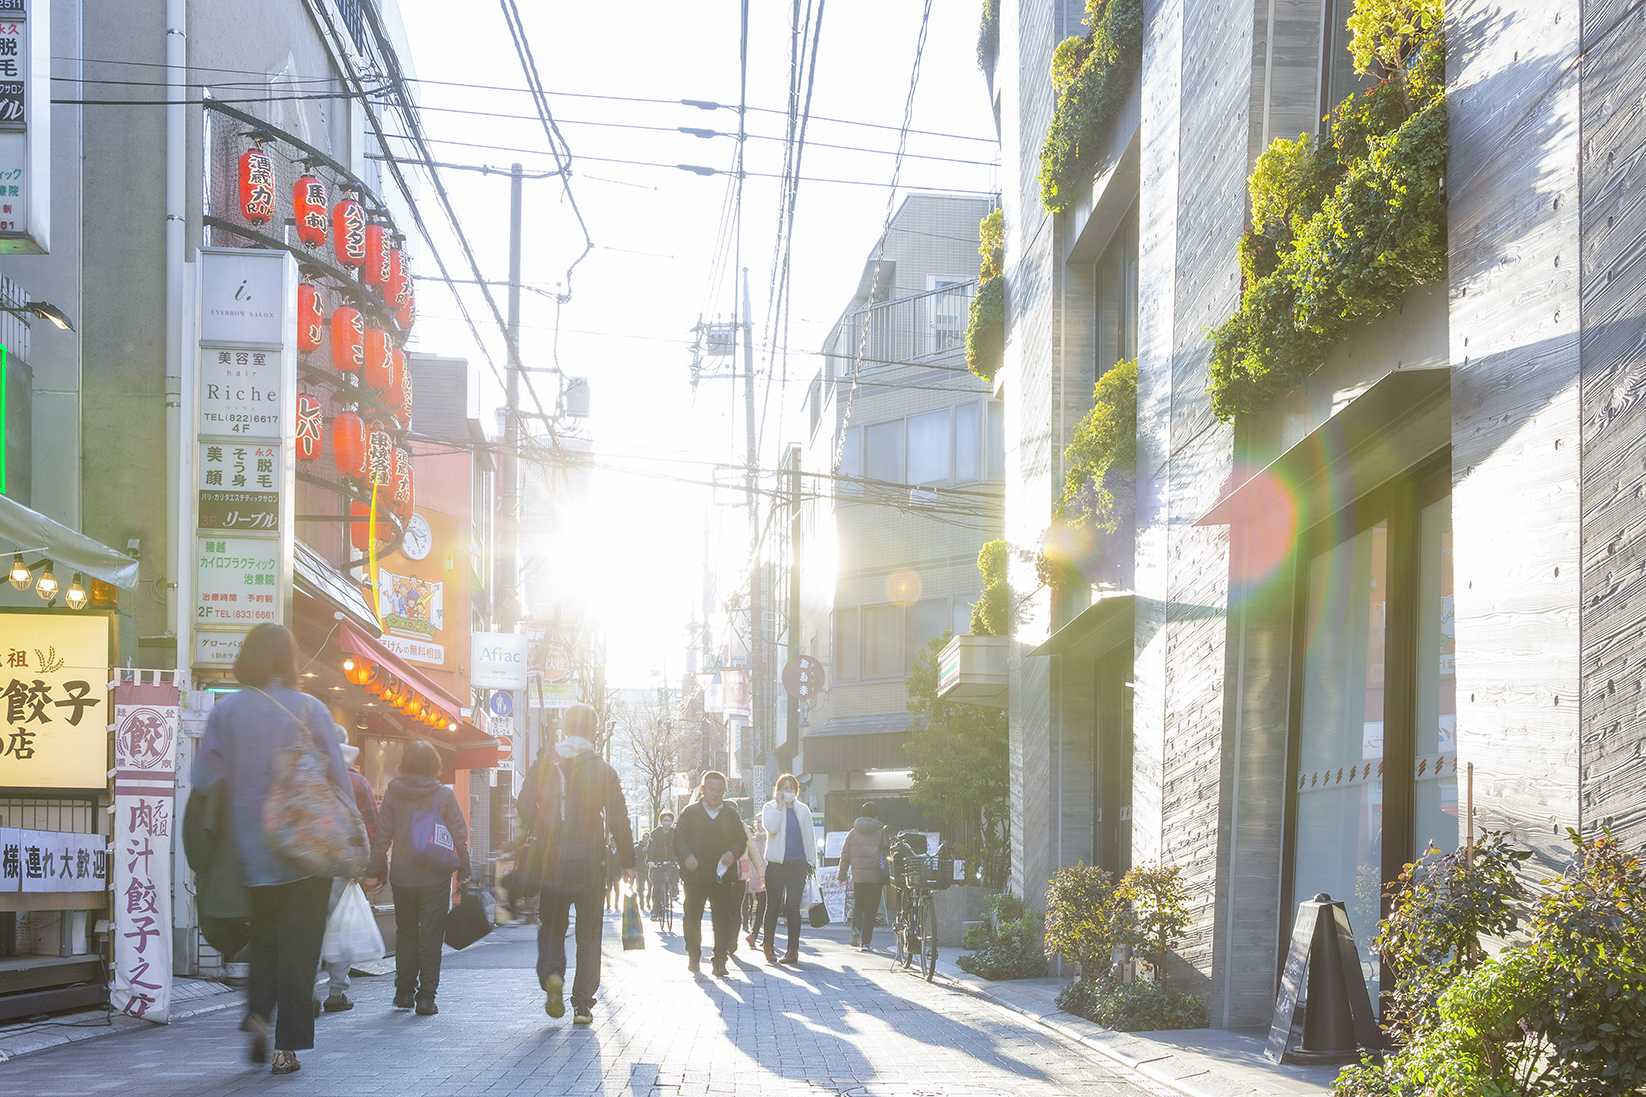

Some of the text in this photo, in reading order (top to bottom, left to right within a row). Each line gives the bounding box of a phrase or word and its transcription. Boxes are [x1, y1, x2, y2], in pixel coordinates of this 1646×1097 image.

[305, 183, 328, 233] 馬刺
[210, 309, 275, 319] EYEBROW SALON
[218, 351, 266, 366] 美容室
[226, 369, 257, 378] hair
[207, 384, 277, 402] Riche
[204, 413, 279, 424] TEL(822)6617
[232, 423, 250, 433] 4F
[255, 448, 274, 457] 永久
[205, 446, 223, 486] 美顔
[232, 448, 247, 487] そう身
[256, 458, 272, 488] 脱毛
[201, 515, 216, 526] 3F
[223, 511, 277, 529] リーブル
[200, 556, 276, 570] カイロプラクティック
[244, 573, 275, 586] 治療院
[202, 592, 237, 602] 治療時間
[247, 594, 273, 603] 予約制
[198, 606, 213, 617] 2F
[215, 609, 275, 619] TEL(833)6661
[0, 648, 28, 668] 祖
[479, 646, 521, 664] Aflac
[0, 678, 101, 727] 餃子
[0, 727, 36, 760] 店
[123, 716, 163, 758] 餃
[153, 800, 169, 837] 元祖
[3, 843, 106, 879] 様連れ大歓迎
[123, 799, 163, 1018] 肉汁餃子之店
